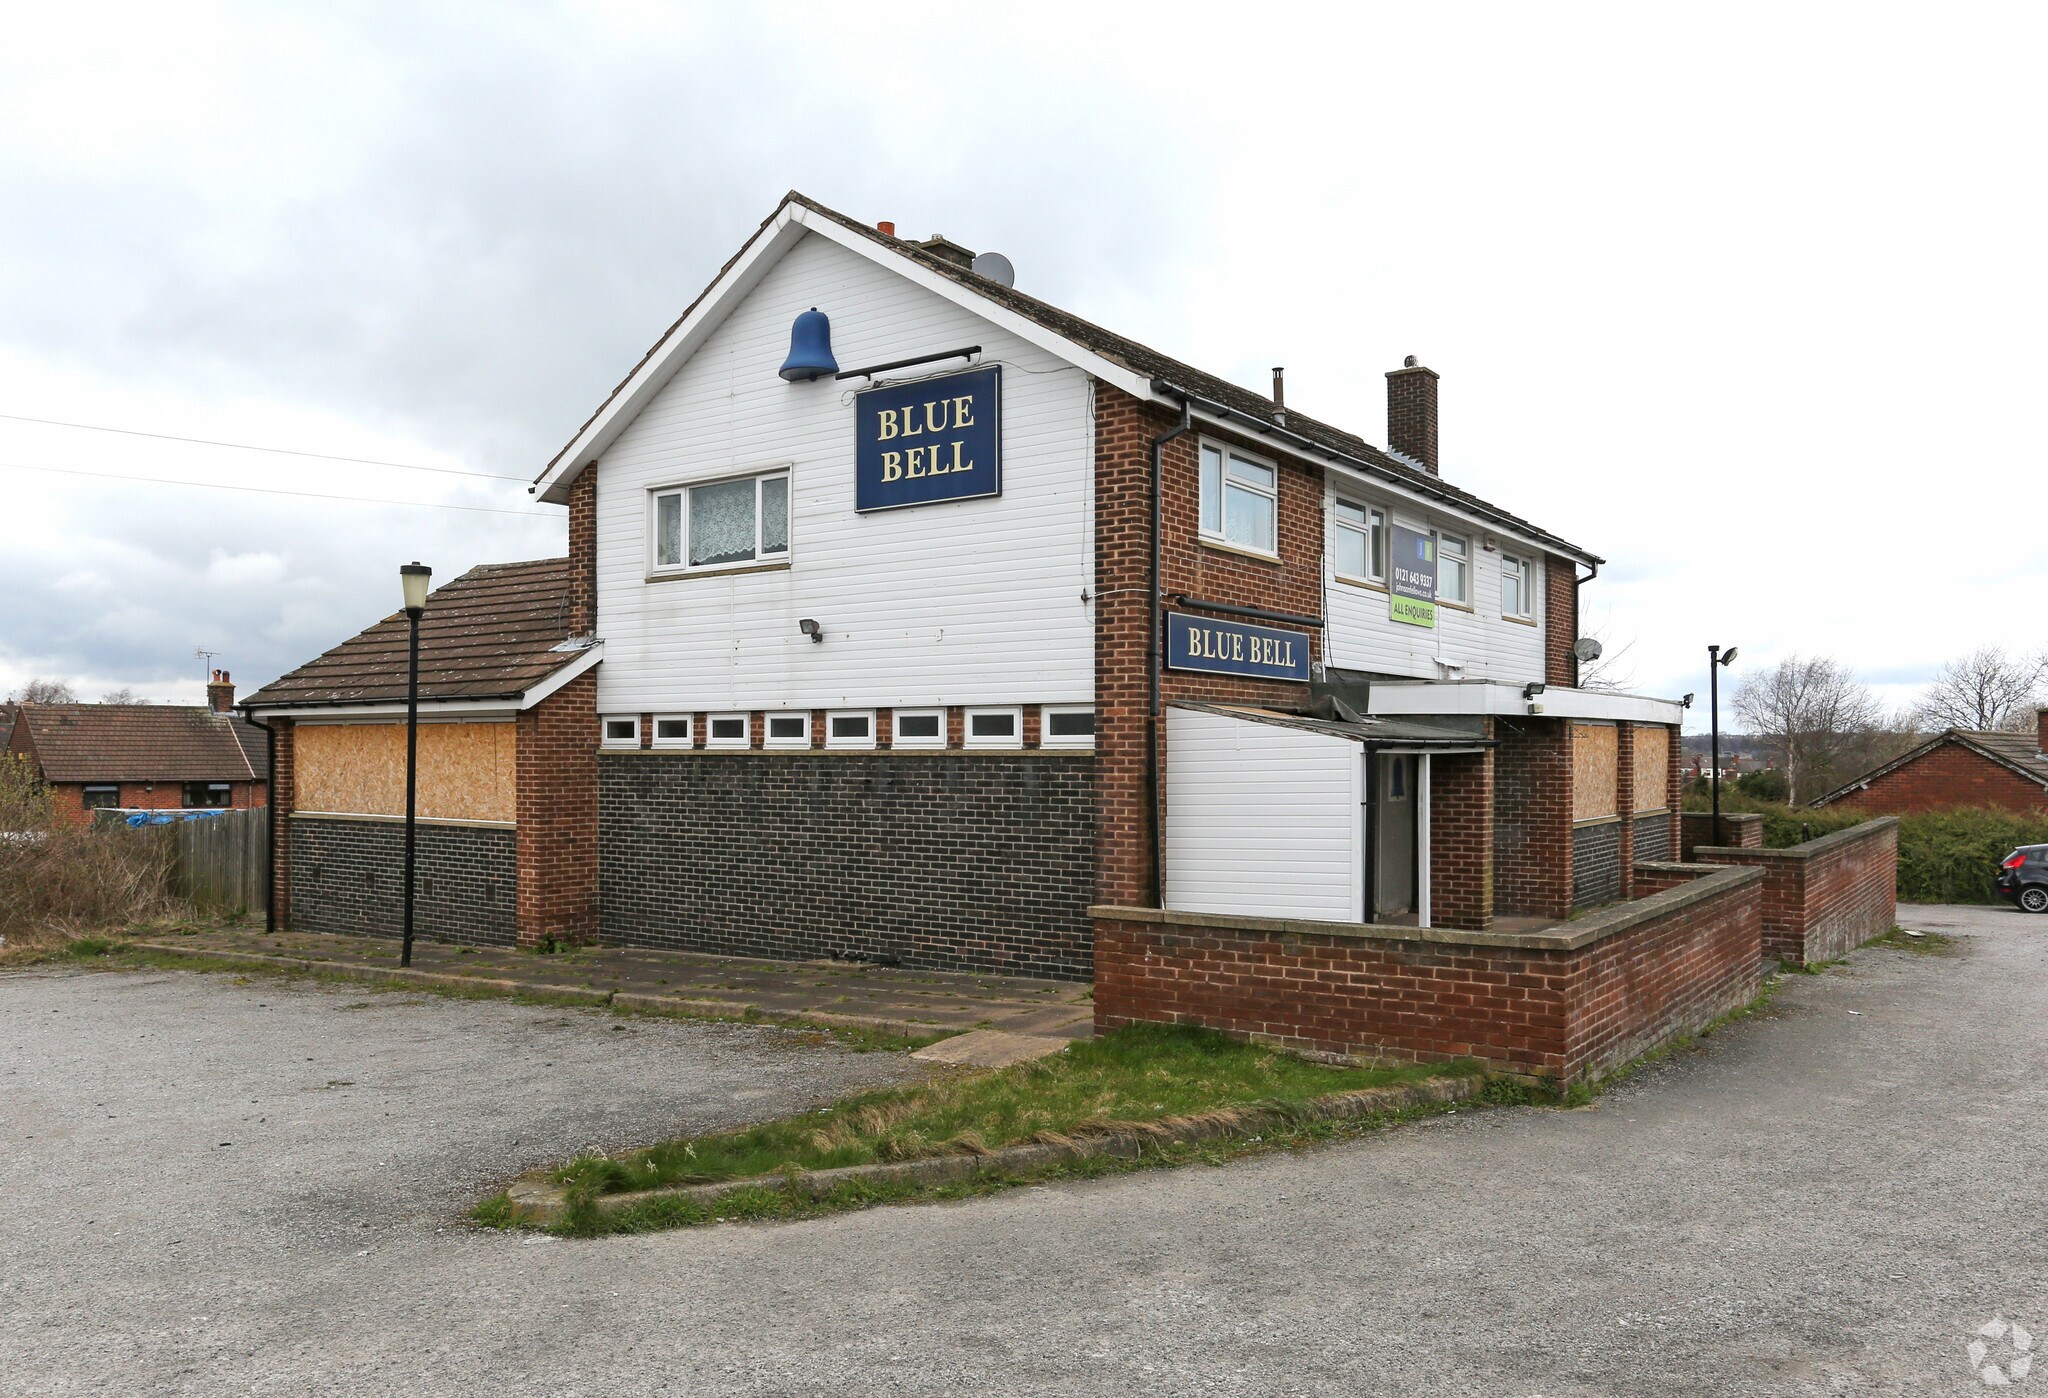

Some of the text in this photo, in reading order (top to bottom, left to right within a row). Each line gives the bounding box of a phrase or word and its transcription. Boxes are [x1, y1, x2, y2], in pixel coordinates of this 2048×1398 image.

[877, 395, 975, 441] BLUE
[881, 441, 973, 483] BELL
[1395, 567, 1433, 588] 0121 643 9337
[1394, 603, 1433, 620] ALL ENQUIRIES
[1188, 627, 1296, 668] BLUE BELL
